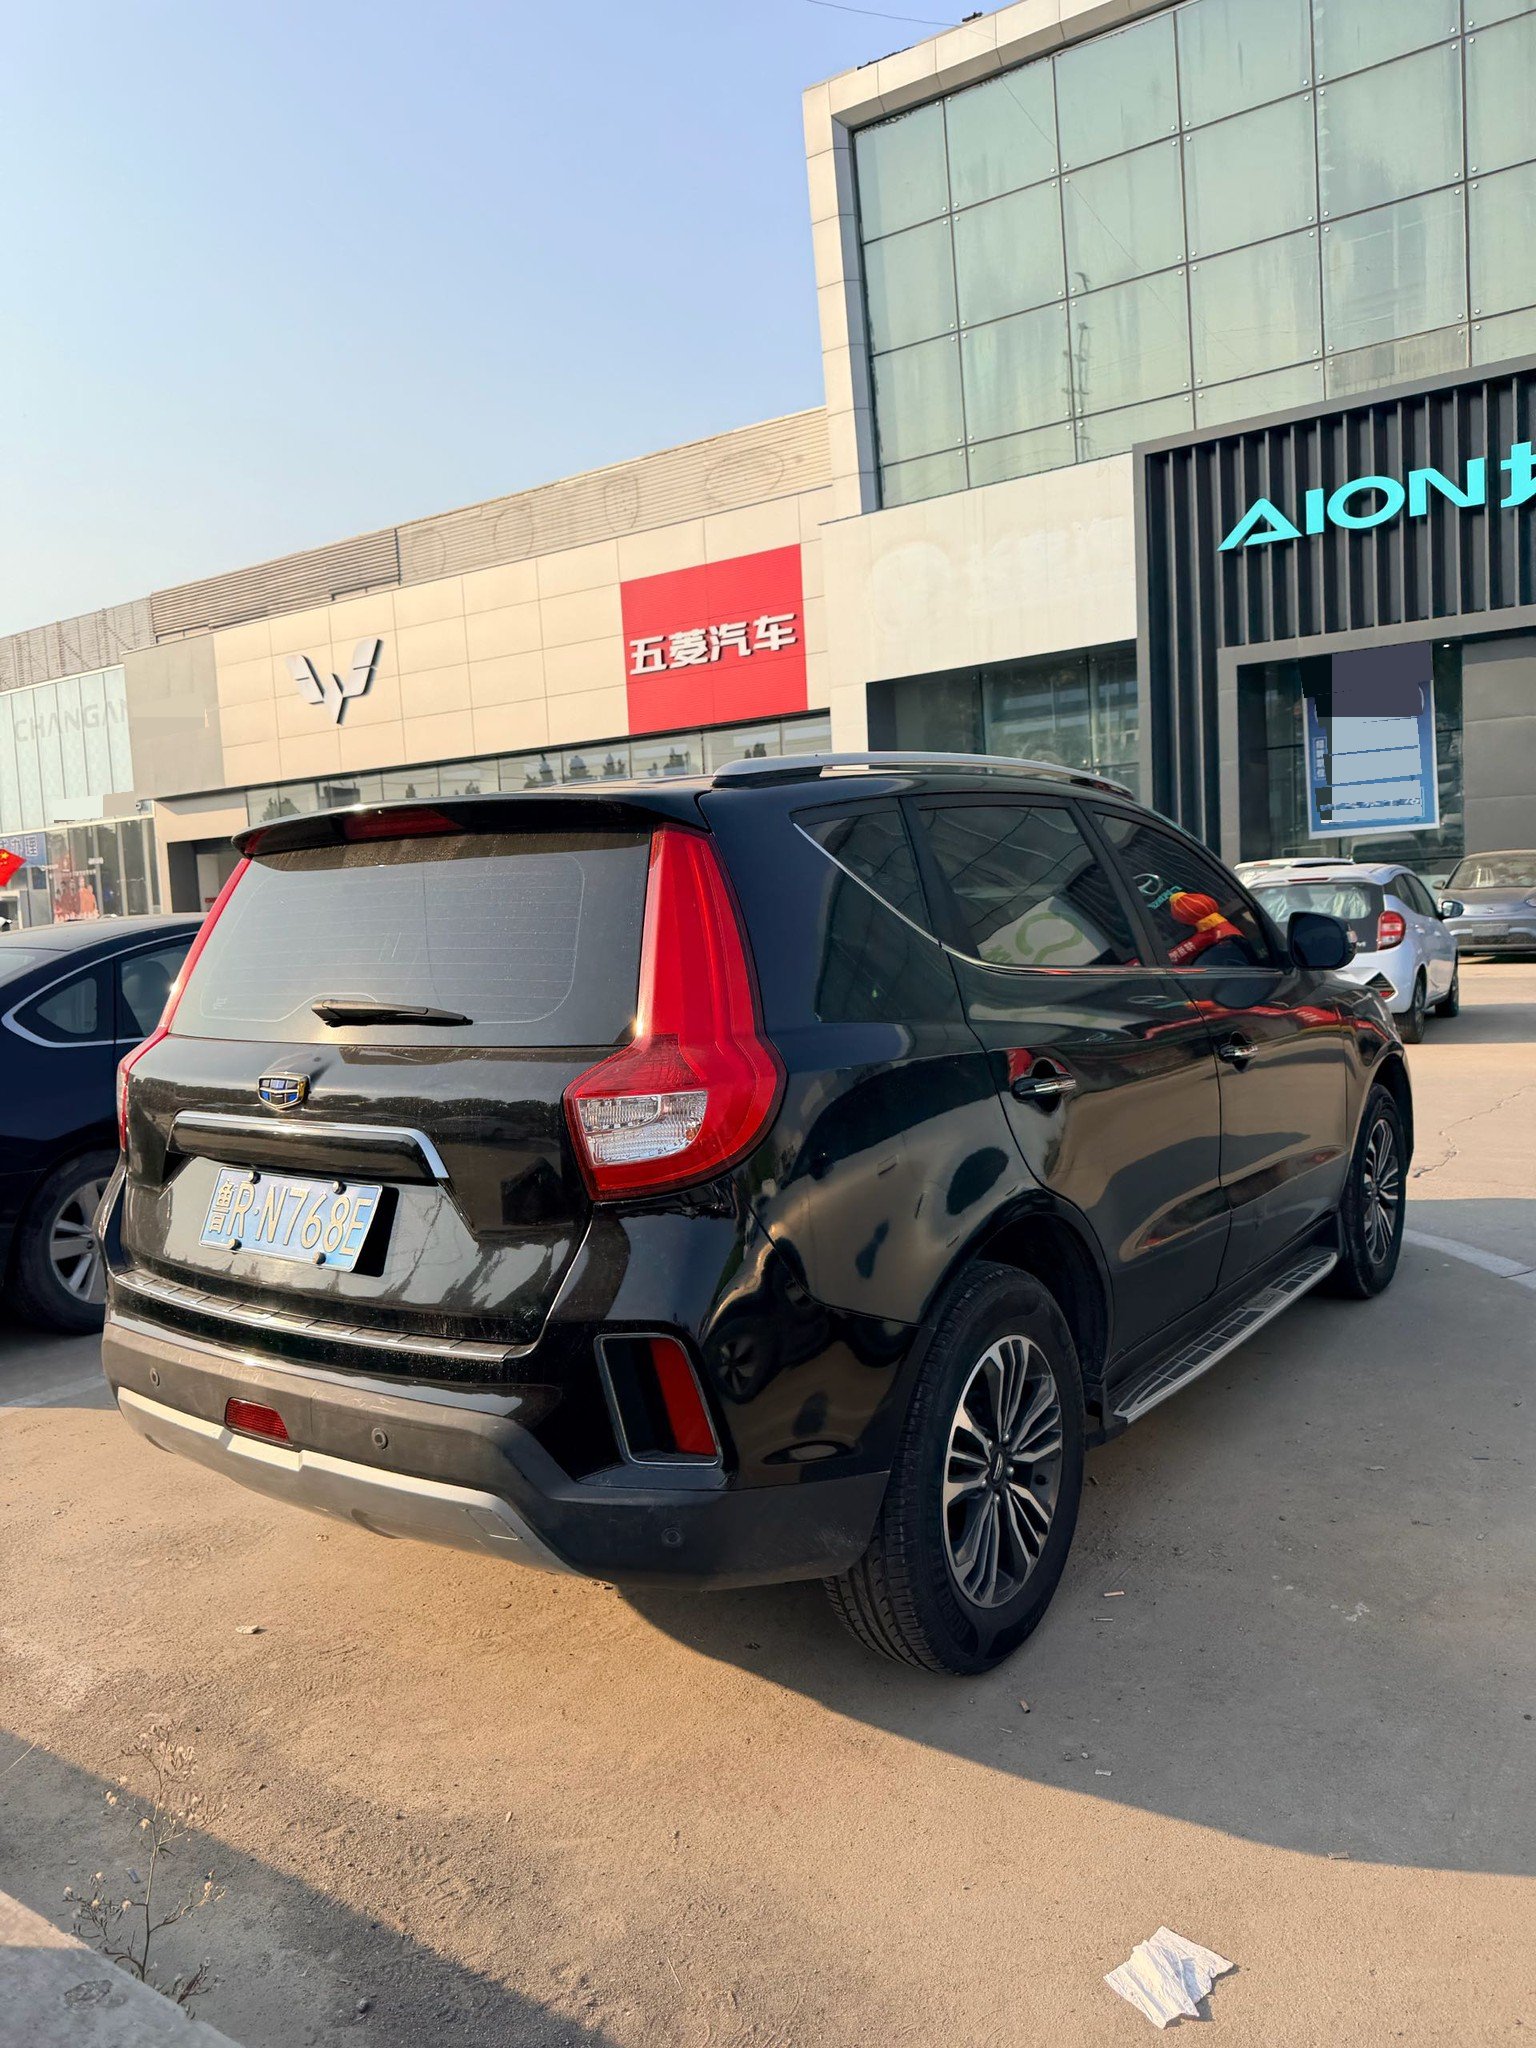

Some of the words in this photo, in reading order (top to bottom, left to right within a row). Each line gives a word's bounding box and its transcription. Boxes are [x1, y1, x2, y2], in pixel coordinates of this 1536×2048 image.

[1217, 457, 1485, 552] AION
[629, 612, 797, 675] 五菱汽车
